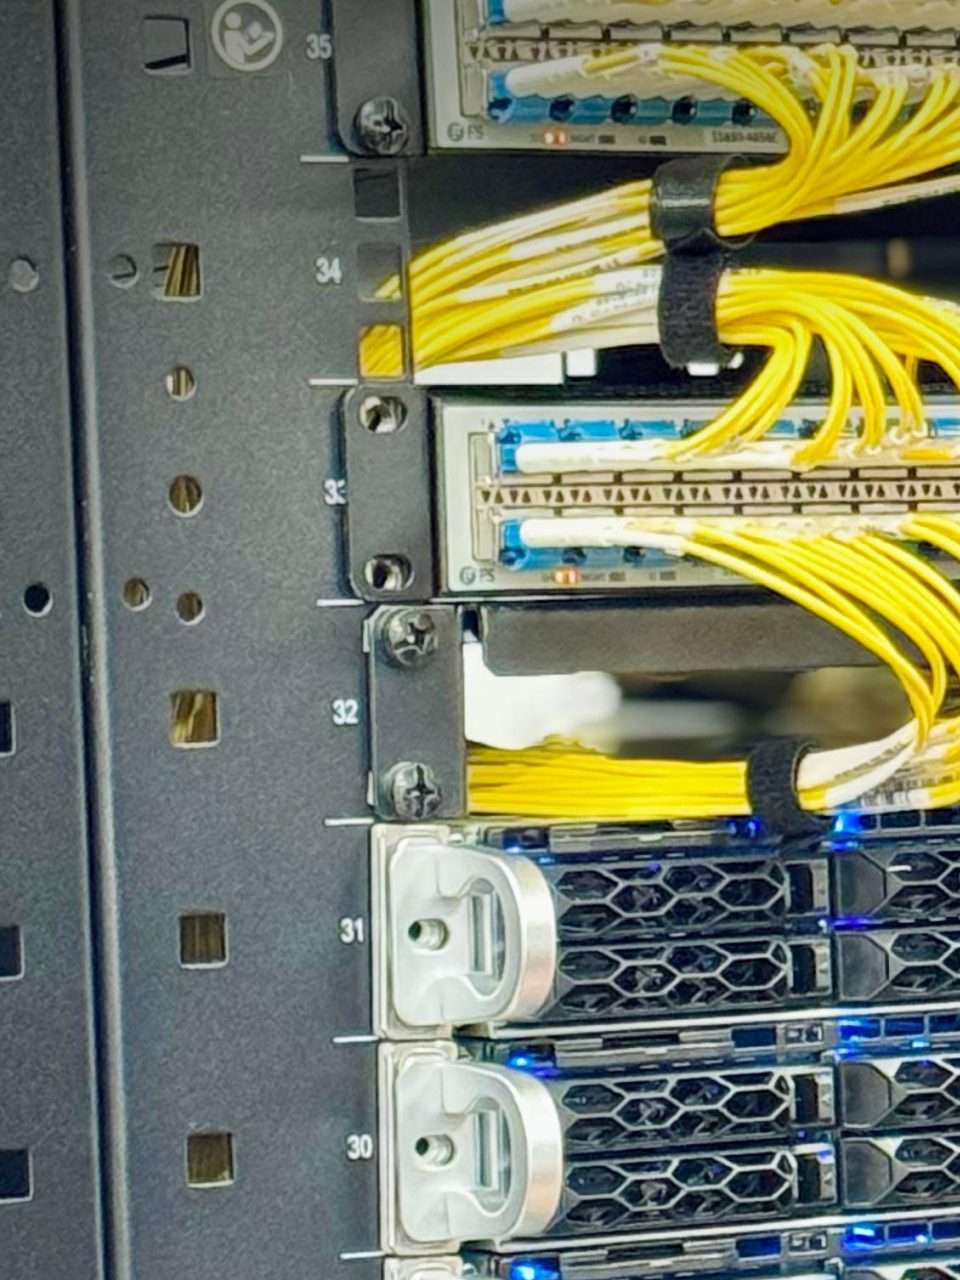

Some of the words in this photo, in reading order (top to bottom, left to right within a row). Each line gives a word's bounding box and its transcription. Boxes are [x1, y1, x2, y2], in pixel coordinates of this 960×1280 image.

[306, 33, 332, 59] 35
[316, 257, 342, 284] 34
[332, 698, 359, 725] 32
[340, 917, 364, 943] 31
[347, 1133, 373, 1160] 30
